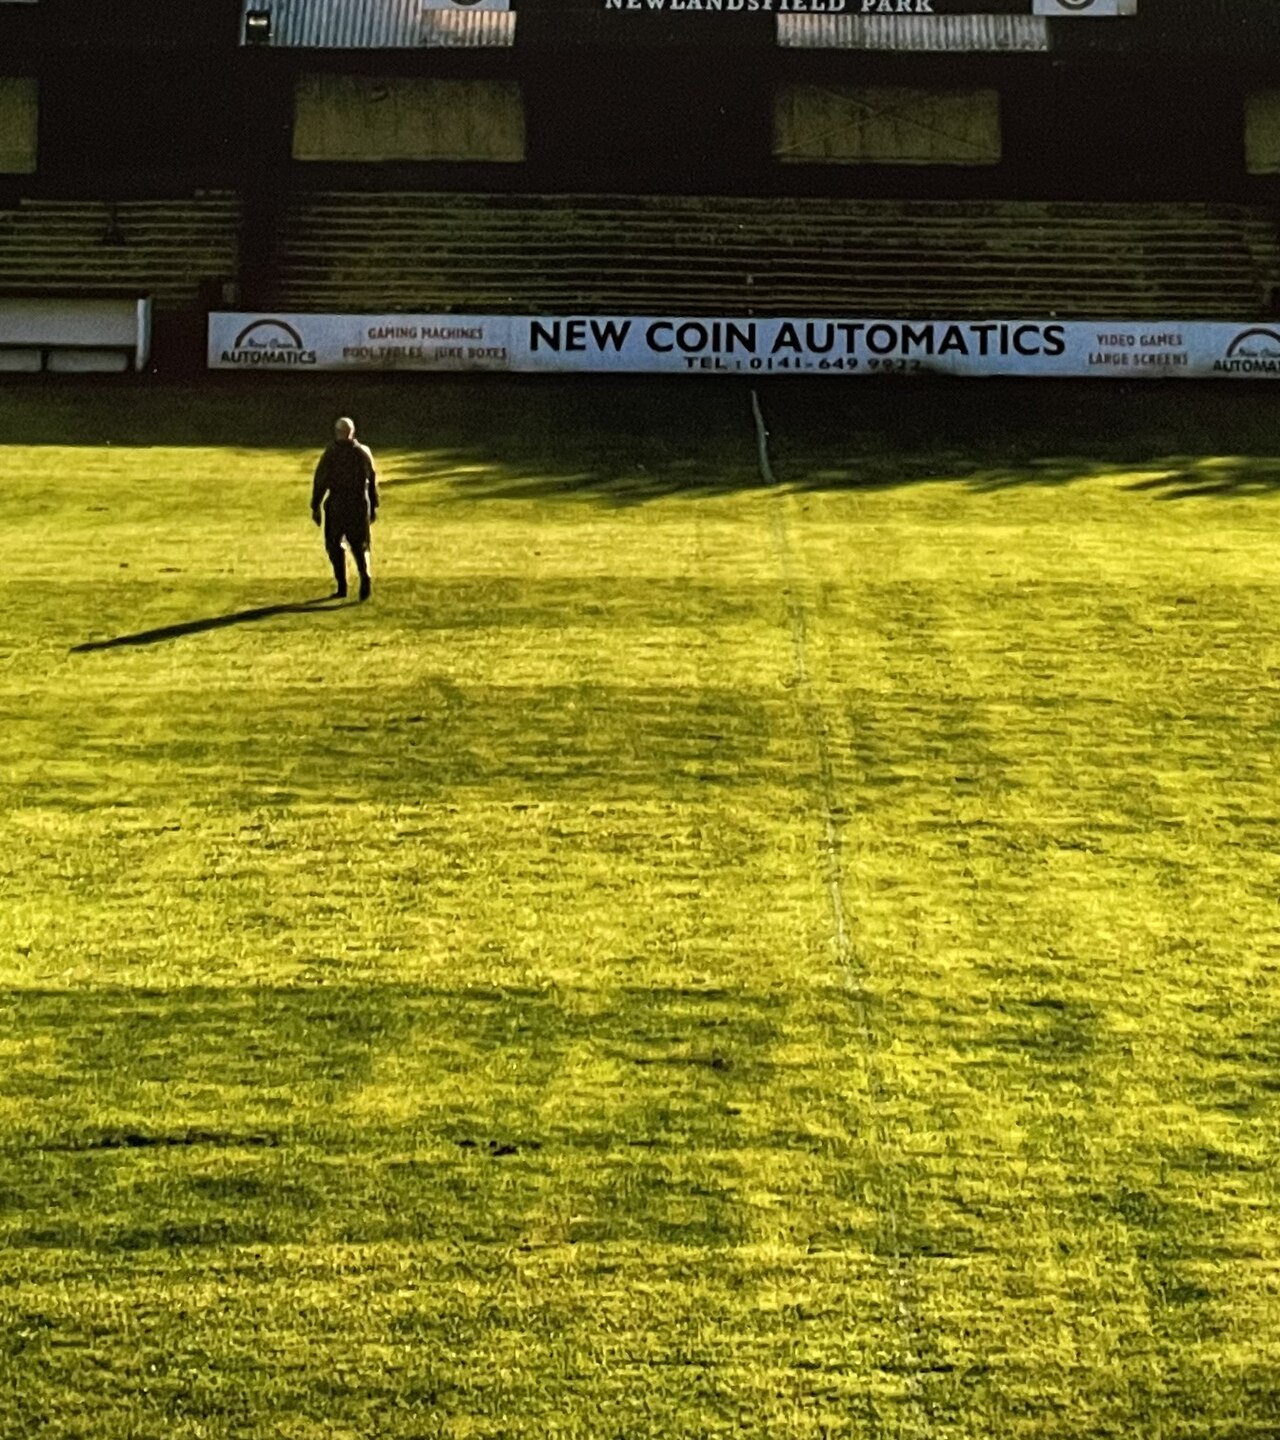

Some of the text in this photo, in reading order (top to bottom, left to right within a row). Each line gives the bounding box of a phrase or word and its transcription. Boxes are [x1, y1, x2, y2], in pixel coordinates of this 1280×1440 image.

[368, 327, 417, 339] GAMING
[530, 320, 1065, 356] NEW COIN AUTOMATICS
[1097, 334, 1183, 347] VIDEO GAMES
[221, 351, 316, 364] AUTOMATICS
[1088, 353, 1188, 366] LARGE SCREENS
